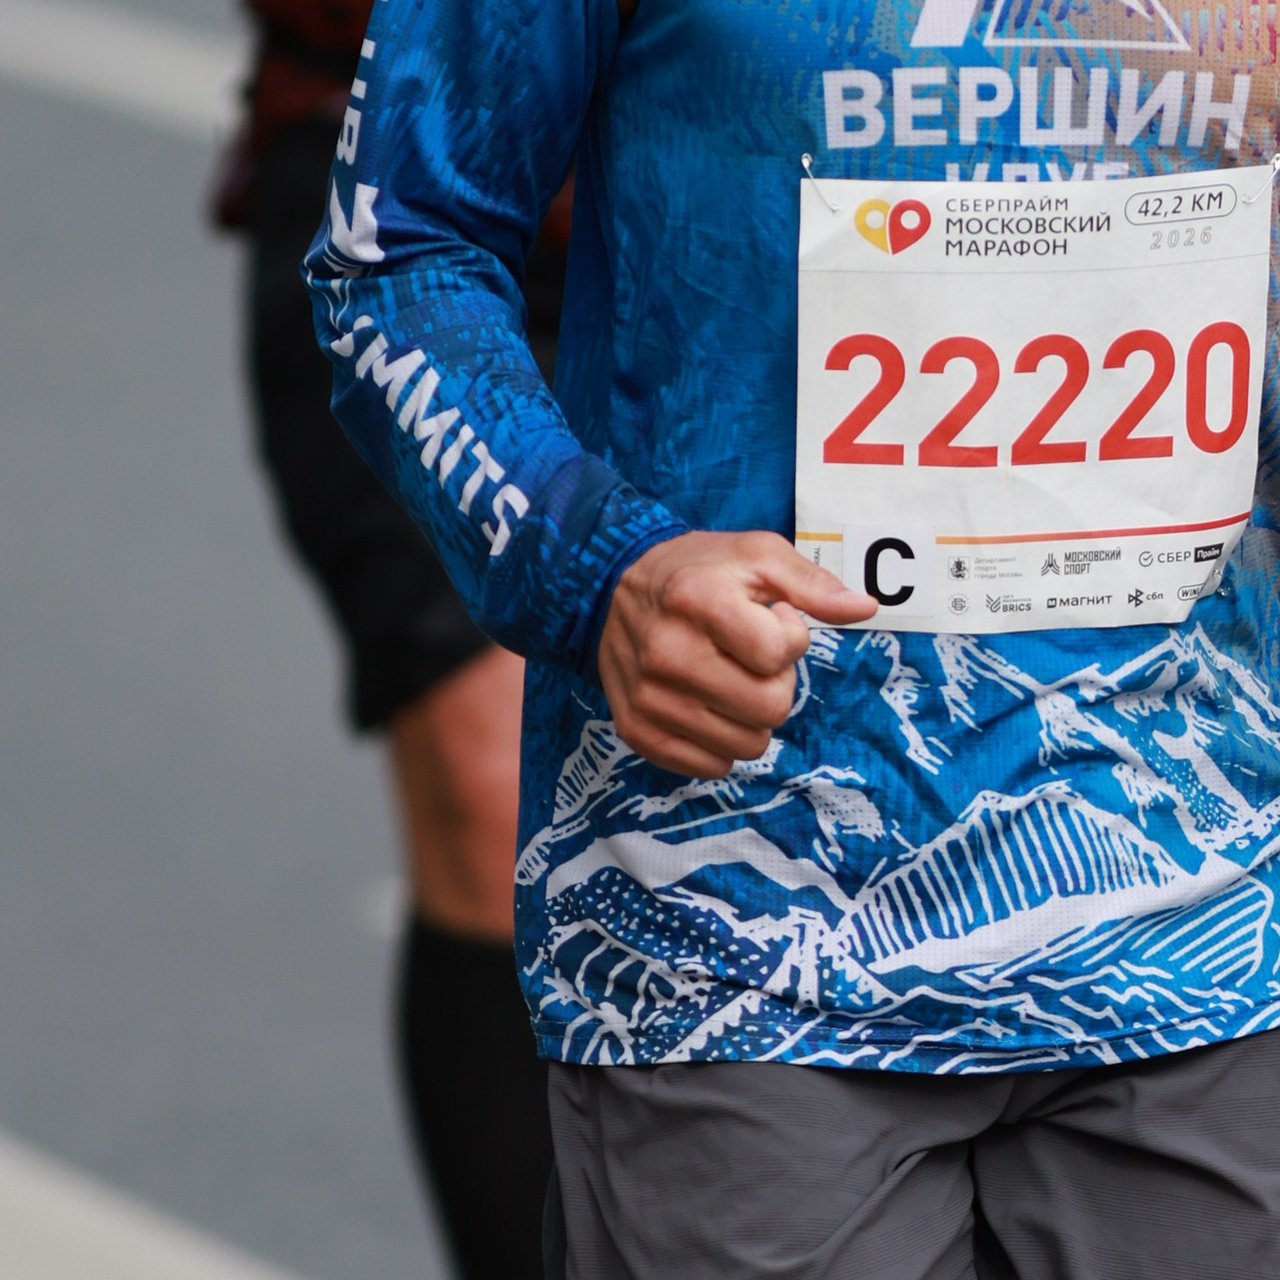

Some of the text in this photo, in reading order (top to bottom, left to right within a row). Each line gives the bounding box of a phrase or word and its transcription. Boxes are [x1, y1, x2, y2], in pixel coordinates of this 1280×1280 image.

[822, 65, 1251, 150] ВЕРШИН
[945, 195, 1069, 212] СБЕРПРАЙМ
[1137, 191, 1223, 218] 42,2 КМ
[945, 212, 1111, 235] МОСКОВСКИЙ
[1150, 226, 1212, 249] 2026
[945, 239, 1068, 257] МАРАФОН
[822, 321, 1251, 468] 22220
[1064, 546, 1122, 563] МОСКОВСКИЙ
[1157, 551, 1192, 564] СБЕР
[1064, 563, 1091, 575] СПОРТ
[1002, 603, 1032, 613] BRICS
